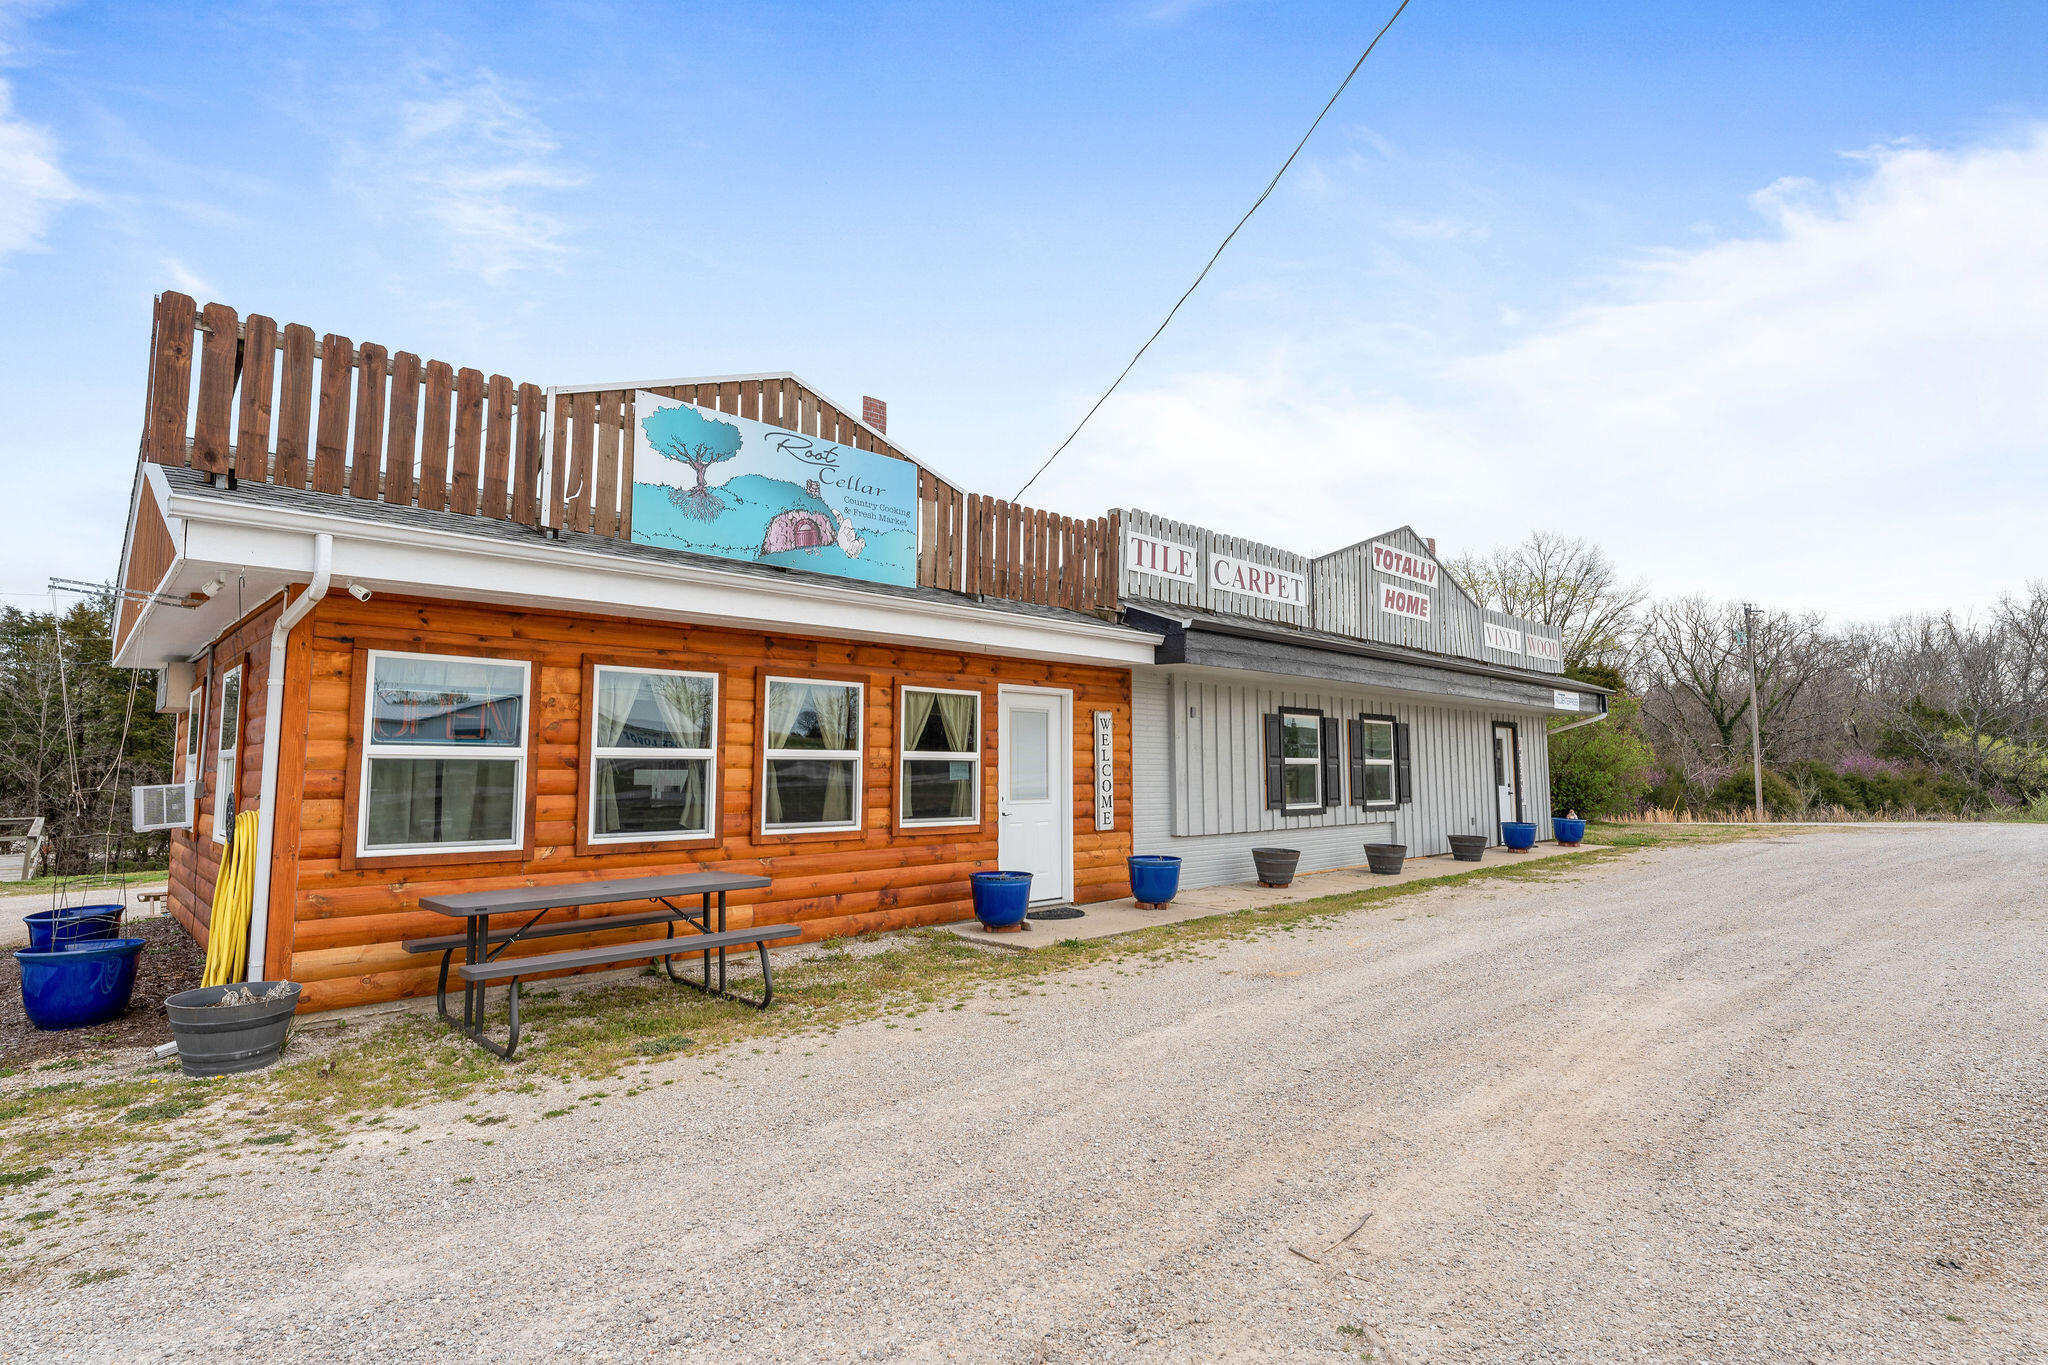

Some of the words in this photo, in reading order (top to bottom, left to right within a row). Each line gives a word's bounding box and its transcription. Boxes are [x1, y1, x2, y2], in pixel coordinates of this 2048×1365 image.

[765, 432, 840, 467] Root
[819, 467, 887, 497] Cellar
[843, 506, 851, 514] &
[853, 509, 877, 520] Fresh
[878, 514, 908, 527] Market
[844, 495, 879, 511] Country
[879, 503, 911, 519] Cooking
[1131, 537, 1193, 578] TILE
[1374, 546, 1436, 583] TOTALLY
[1214, 559, 1303, 602] CARPET
[1384, 589, 1428, 618] HOME
[1486, 626, 1521, 652] VINYL
[1527, 636, 1559, 659] WOOD
[1100, 718, 1113, 825] WELCOME
